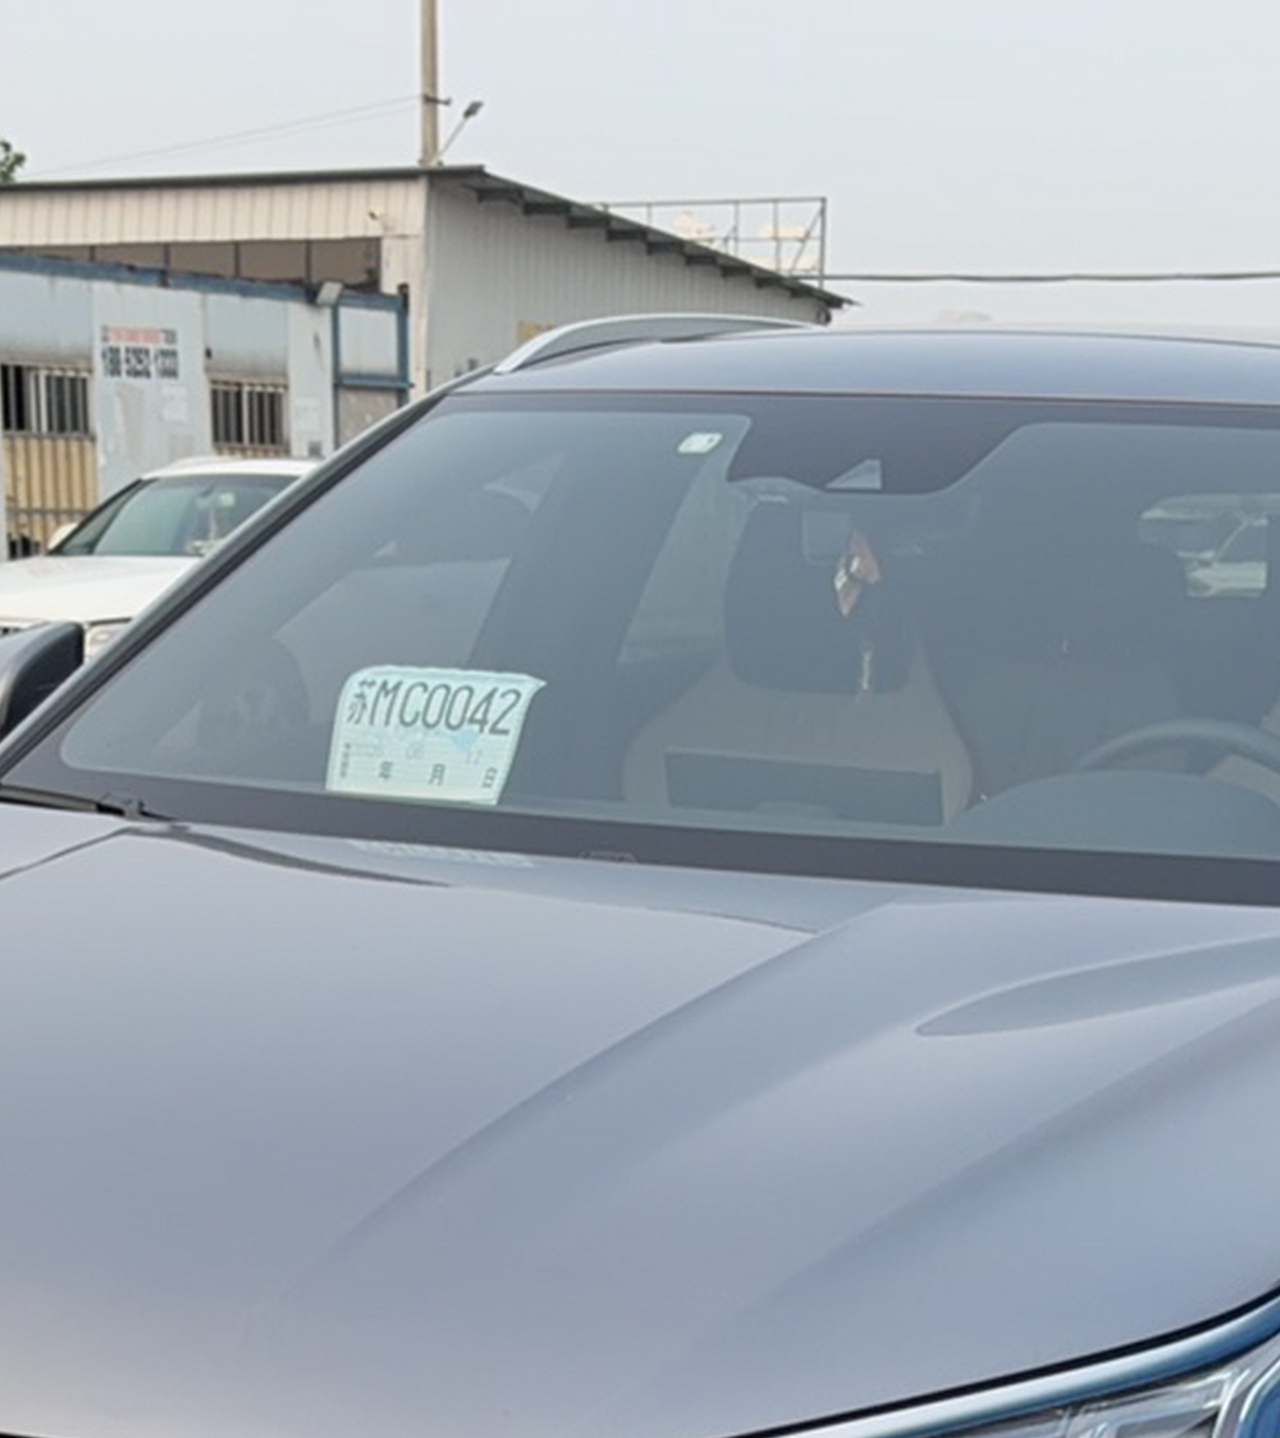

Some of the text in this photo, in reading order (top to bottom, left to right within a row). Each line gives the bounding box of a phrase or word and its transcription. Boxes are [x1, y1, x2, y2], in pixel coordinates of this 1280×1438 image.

[346, 679, 521, 736] 苏MC0042
[428, 763, 446, 786] 月
[481, 766, 498, 788] 日
